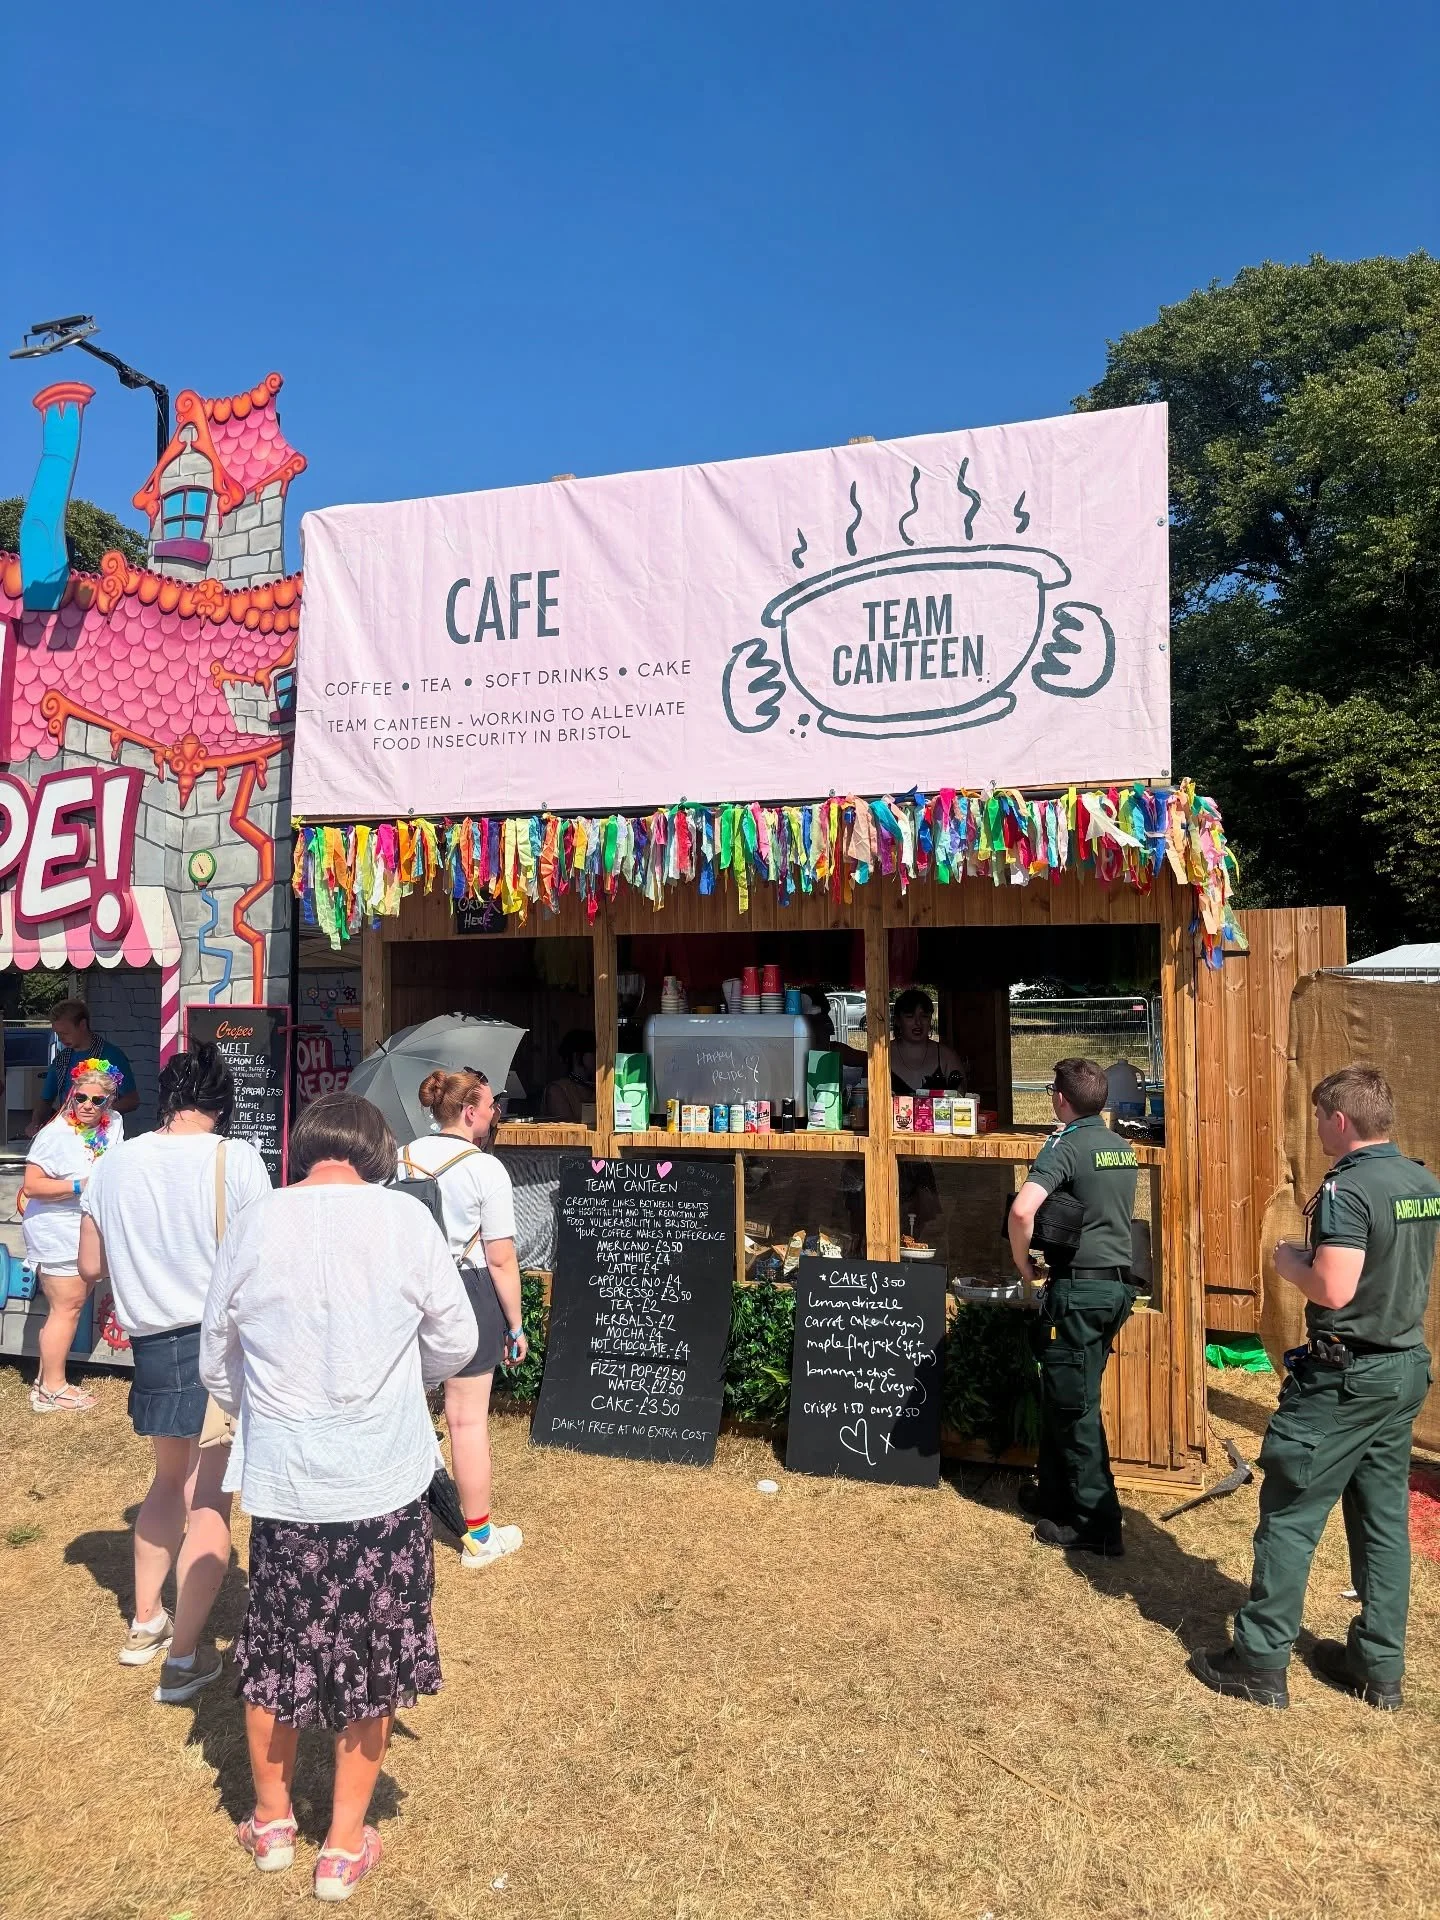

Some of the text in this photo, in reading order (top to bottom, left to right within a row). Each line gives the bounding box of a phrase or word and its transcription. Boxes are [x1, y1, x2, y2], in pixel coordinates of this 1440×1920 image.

[445, 569, 560, 645] CAFE
[862, 593, 954, 642] TEAM
[832, 634, 985, 686] CANTEEN
[324, 659, 692, 697] COFFEE TEA SOFT DRINKS CAKE
[328, 719, 367, 733] TEAM
[373, 716, 451, 732] CANTEEN
[470, 709, 556, 728] WORKING
[561, 707, 584, 721] TO
[591, 701, 686, 719] ALLEVIATE
[373, 726, 632, 751] FOOD INSECURITY IN BRISTOL
[216, 1020, 254, 1040] Crepes
[216, 1042, 251, 1056] SWEET
[239, 1111, 254, 1121] PIE
[605, 1161, 650, 1179] MENU
[586, 1178, 616, 1192] TEAM
[623, 1179, 678, 1193] CANTEEN
[565, 1196, 709, 1211] CREATING LINKS BETWEEN EVENTS
[563, 1207, 575, 1216] AND
[578, 1206, 623, 1218] HOSPITALITY
[642, 1208, 656, 1218] THE
[698, 1211, 709, 1219] OF
[566, 1216, 585, 1226] FOOD
[589, 1217, 651, 1229] VULNERABILITY
[653, 1218, 662, 1228] IN
[664, 1218, 702, 1230] BRISTOL
[575, 1226, 726, 1241] YOUR COFFEE MAKES A DIFFERENCE
[596, 1252, 621, 1262] FLAT
[829, 1270, 878, 1295] CAKES
[851, 1295, 904, 1310] drizzle
[590, 1336, 611, 1351] HOT
[612, 1338, 668, 1354] CHOCOLATE
[590, 1361, 627, 1378] FIZZY
[866, 1367, 897, 1378] choc
[551, 1417, 712, 1442] DAIRY FREE AT NO EXTRA COST
